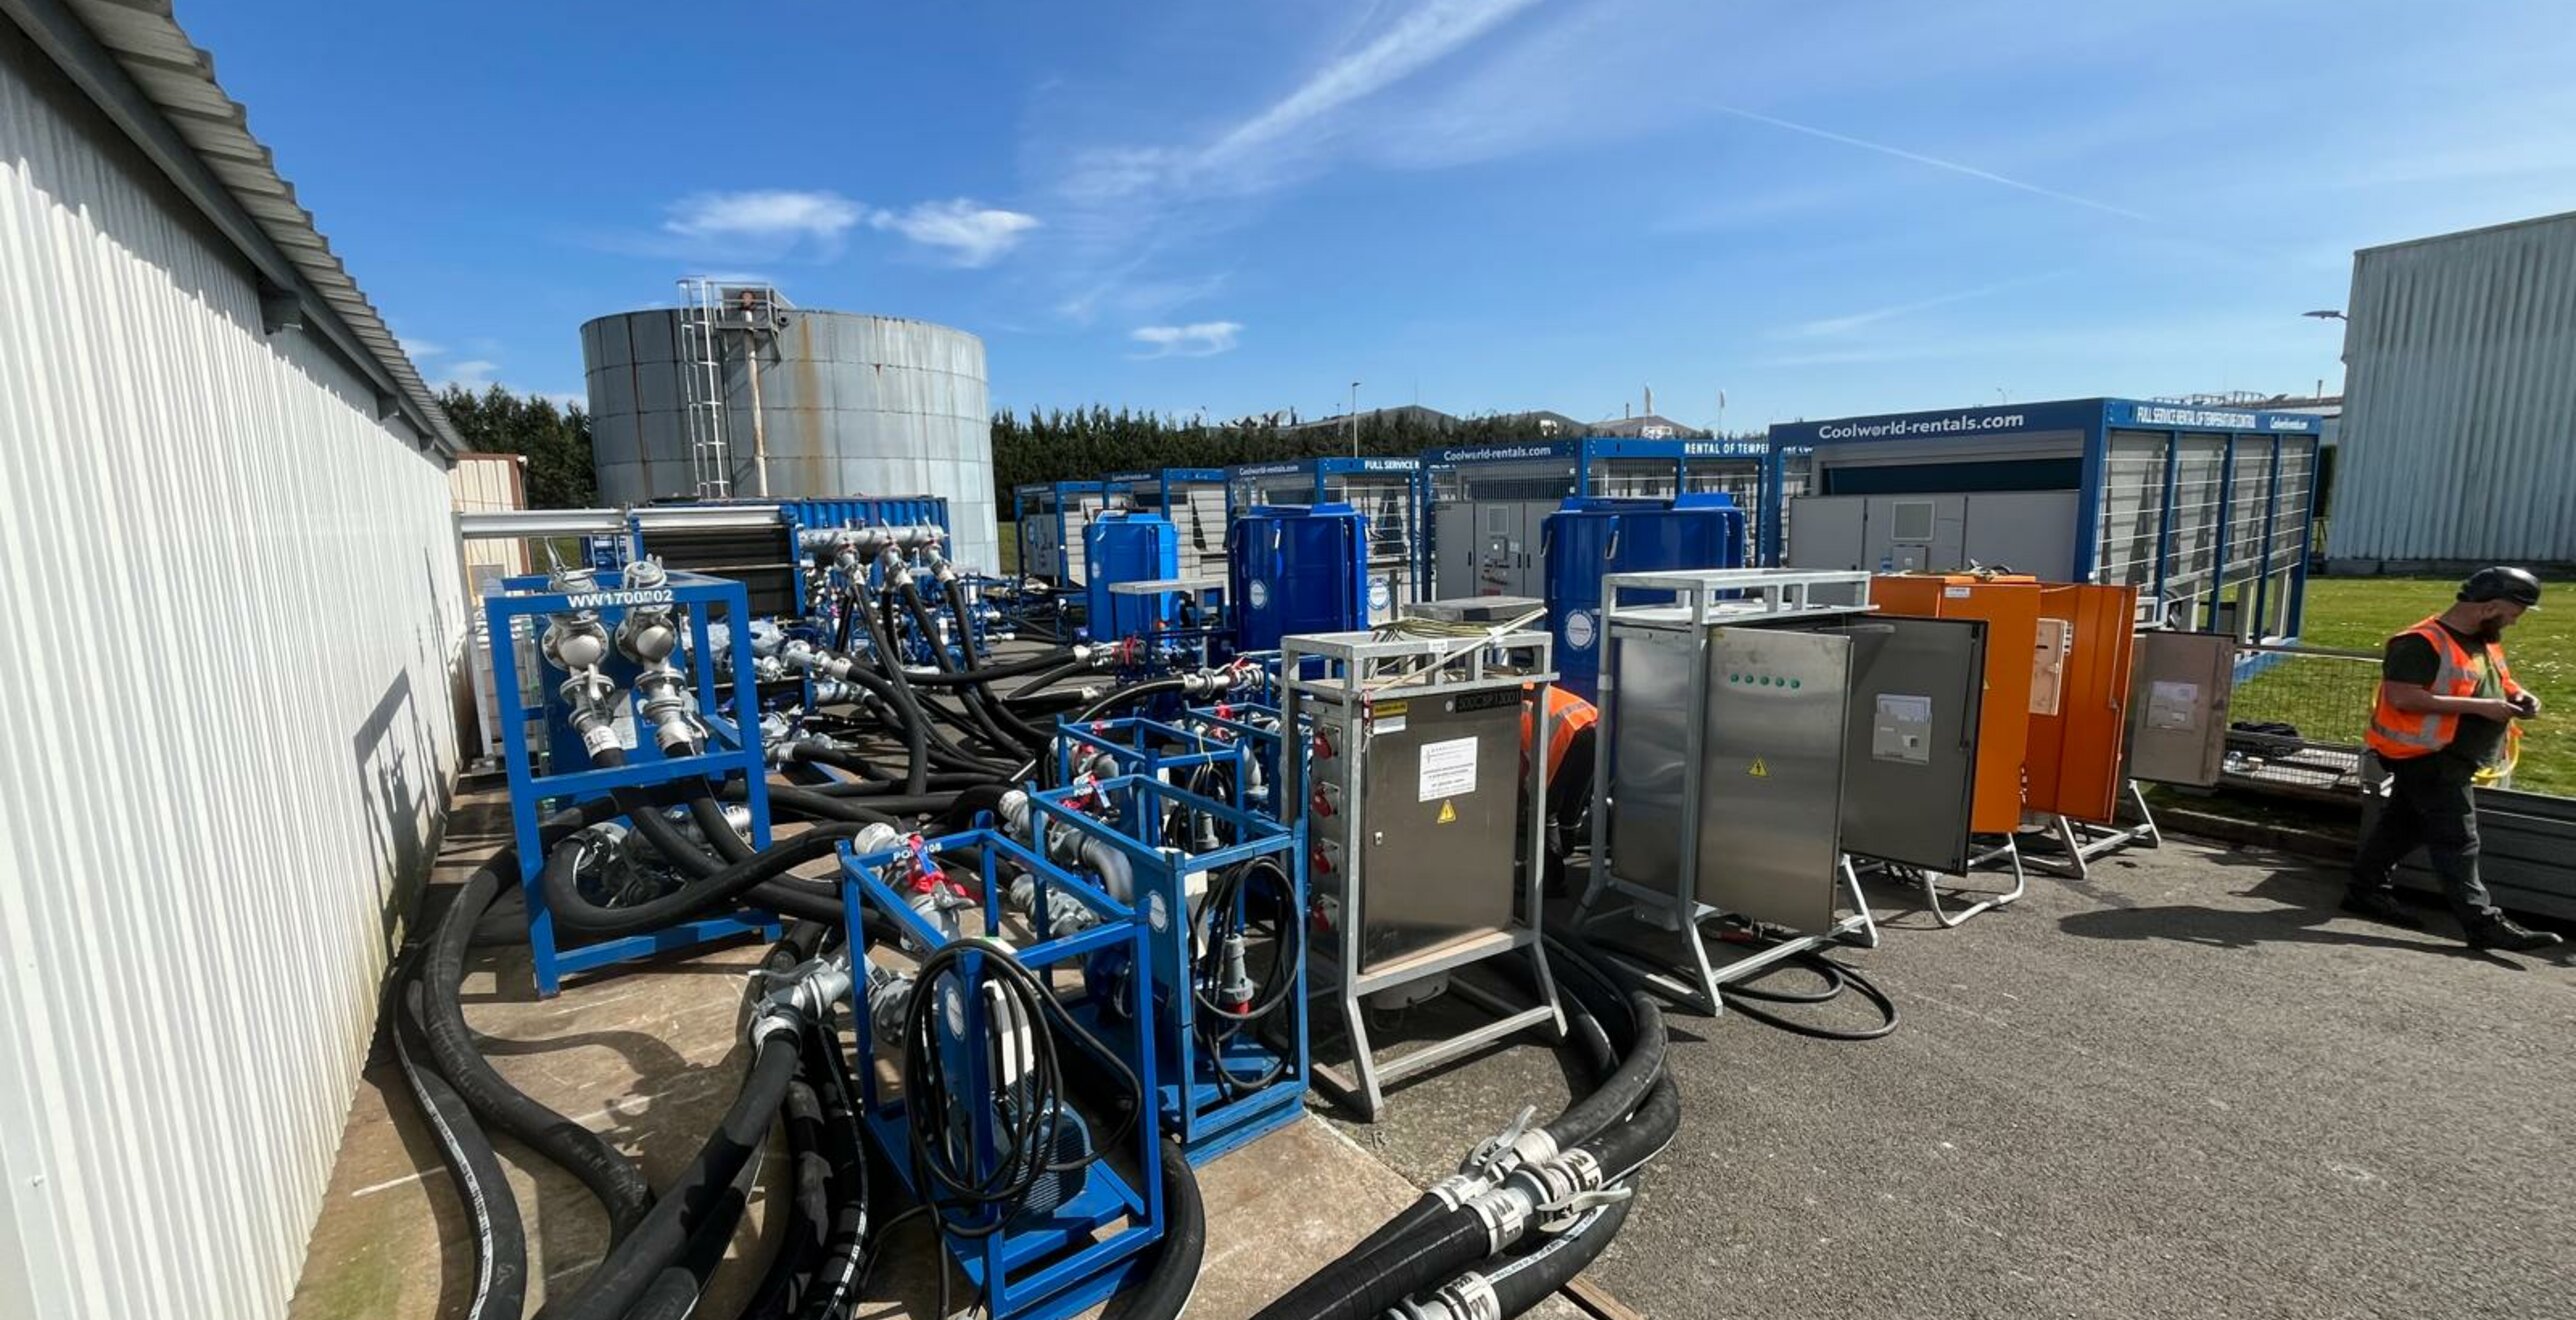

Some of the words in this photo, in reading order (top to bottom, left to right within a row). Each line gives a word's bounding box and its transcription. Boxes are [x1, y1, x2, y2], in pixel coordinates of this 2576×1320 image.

[2136, 406, 2154, 424] FULL
[1818, 413, 2025, 440] Coolworld-rentals.com
[1443, 447, 1551, 461] Coolworld-rentals.com
[1684, 442, 1720, 455] RENTAL
[1723, 442, 1735, 455] OF
[1364, 460, 1383, 470] FULL
[1384, 460, 1413, 470] SERVICE
